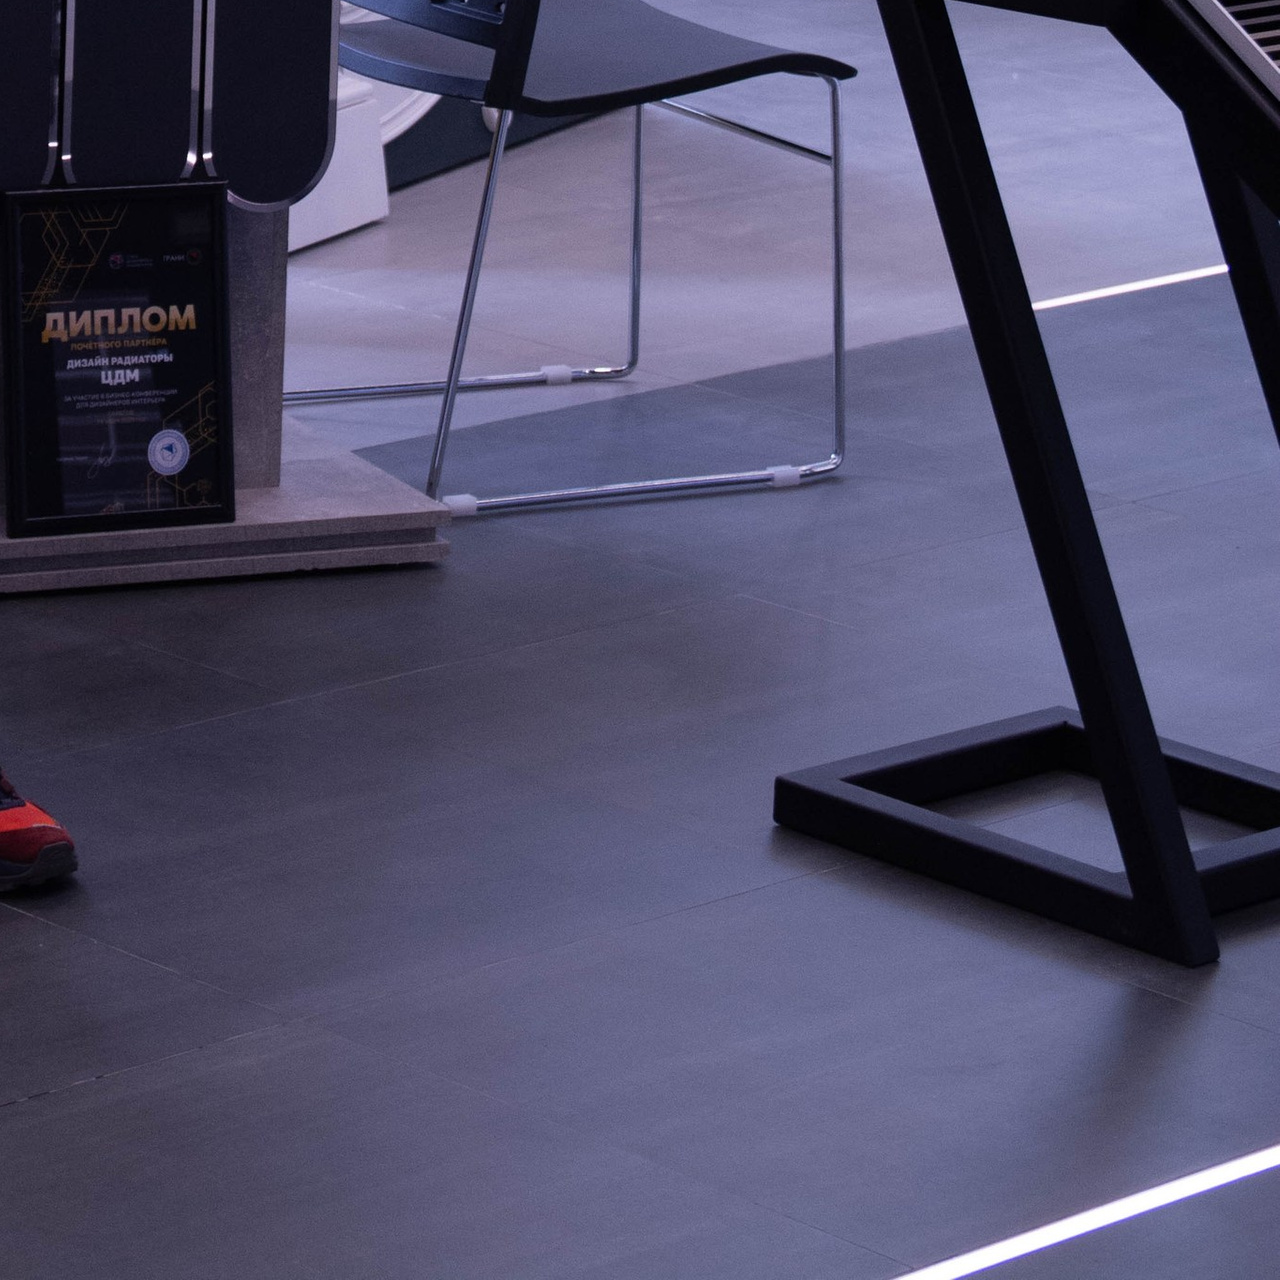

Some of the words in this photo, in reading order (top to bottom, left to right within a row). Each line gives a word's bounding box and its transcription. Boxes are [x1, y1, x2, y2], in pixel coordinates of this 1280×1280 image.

[41, 304, 197, 344] ДИПЛОМ
[66, 355, 109, 370] ДИЗАЙН
[111, 352, 174, 366] РАДИАТОРЫ
[100, 369, 140, 386] ЦДМ
